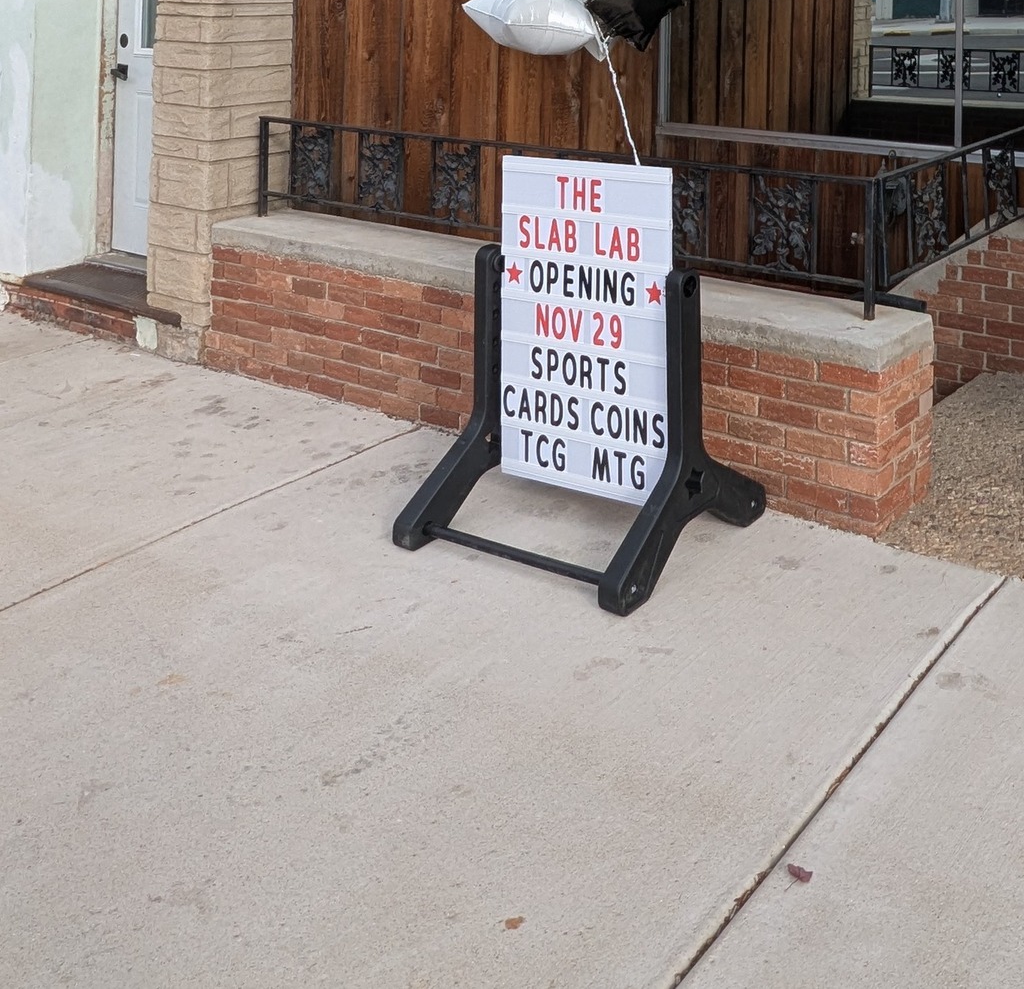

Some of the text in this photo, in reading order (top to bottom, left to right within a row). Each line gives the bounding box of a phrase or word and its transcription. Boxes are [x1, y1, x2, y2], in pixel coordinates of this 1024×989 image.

[556, 176, 603, 213] THE
[518, 215, 641, 262] SLAB LAB
[529, 259, 636, 307] OPENING
[535, 303, 624, 350] NOV 29
[530, 346, 628, 396] SPORTS
[503, 384, 665, 450] CARDS COINS
[520, 429, 646, 491] TCG MTG
